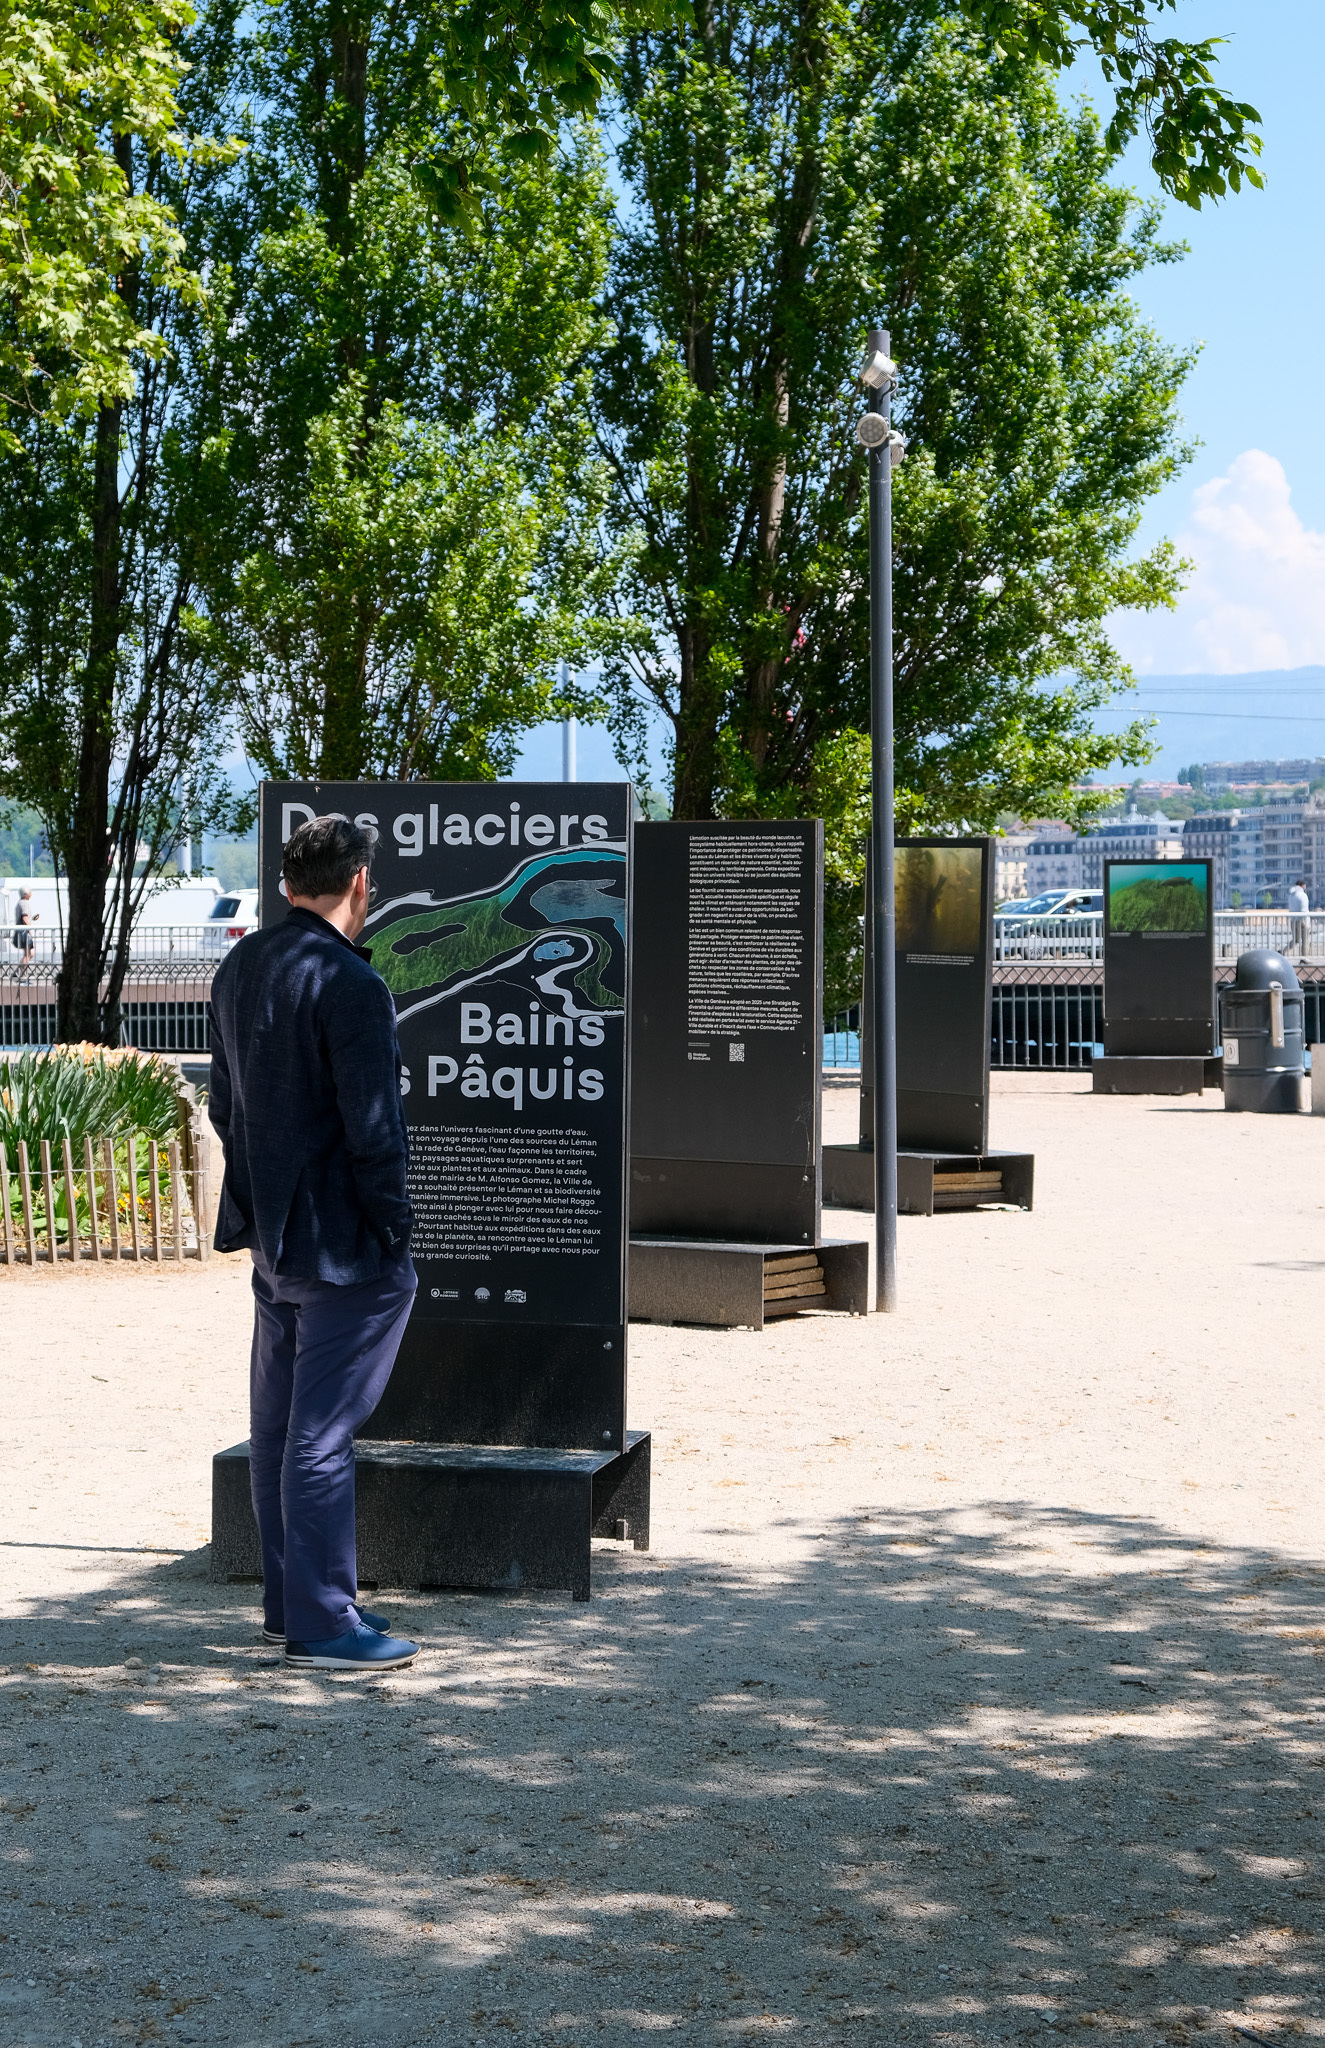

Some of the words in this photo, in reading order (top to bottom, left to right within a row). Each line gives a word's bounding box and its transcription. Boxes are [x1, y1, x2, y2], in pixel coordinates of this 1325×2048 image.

[282, 802, 379, 844] Ds
[392, 801, 609, 857] glaciers
[460, 1002, 605, 1047] Bains
[428, 1053, 605, 1111] Pâquis
[440, 1125, 473, 1133] l'univers
[475, 1126, 511, 1134] fascinant
[513, 1127, 535, 1135] d'une
[536, 1128, 563, 1137] goutte
[565, 1128, 588, 1136] d'eau.
[431, 1136, 460, 1145] voyage
[461, 1135, 487, 1145] depuis
[489, 1136, 508, 1144] l'une
[570, 1138, 597, 1146] Léman
[424, 1144, 442, 1152] rade
[443, 1144, 453, 1152] de
[454, 1145, 487, 1154] Genève,
[508, 1146, 540, 1156] façonne
[555, 1147, 597, 1157] territoires,
[422, 1155, 459, 1164] paysages
[460, 1155, 504, 1165] aquatiques
[506, 1157, 554, 1167] surprenants
[413, 1163, 425, 1171] vie
[442, 1164, 471, 1174] plantes
[497, 1166, 532, 1174] animaux.
[534, 1167, 554, 1175] Dans
[555, 1167, 563, 1175] le
[407, 1172, 426, 1180] nnée
[427, 1173, 438, 1181] de
[439, 1173, 464, 1181] mairie
[465, 1174, 476, 1182] de
[489, 1175, 520, 1183] Alfonso
[521, 1176, 552, 1186] Gomez,
[562, 1177, 580, 1185] Ville
[424, 1183, 457, 1191] souhaité
[458, 1184, 496, 1194] présenter
[498, 1185, 505, 1193] le
[506, 1185, 532, 1193] Léman
[554, 1187, 601, 1195] biodiversité
[439, 1194, 480, 1202] immersive.
[492, 1195, 541, 1206] photographe
[543, 1196, 568, 1204] Michel
[570, 1197, 595, 1207] Roggo
[428, 1203, 446, 1211] ainsi
[448, 1203, 453, 1211] à
[454, 1204, 484, 1214] plonger
[515, 1207, 533, 1215] pour
[555, 1206, 573, 1214] faire
[574, 1207, 602, 1215] décou-
[414, 1212, 442, 1220] trésors
[443, 1213, 471, 1221] cachés
[492, 1214, 500, 1222] le
[501, 1215, 524, 1223] miroir
[525, 1215, 540, 1223] des
[418, 1222, 452, 1230] Pourtant
[453, 1223, 483, 1231] habitué
[499, 1224, 544, 1235] expéditions
[566, 1226, 581, 1234] des
[444, 1232, 475, 1243] planète,
[487, 1234, 526, 1242] rencontre
[556, 1236, 582, 1244] Léman
[422, 1241, 439, 1249] bien
[440, 1242, 454, 1250] des
[455, 1242, 491, 1253] surprises
[492, 1244, 508, 1254] qu'il
[510, 1245, 540, 1255] partage
[581, 1248, 600, 1256] pour
[426, 1251, 453, 1261] grande
[455, 1252, 491, 1261] curiosité.
